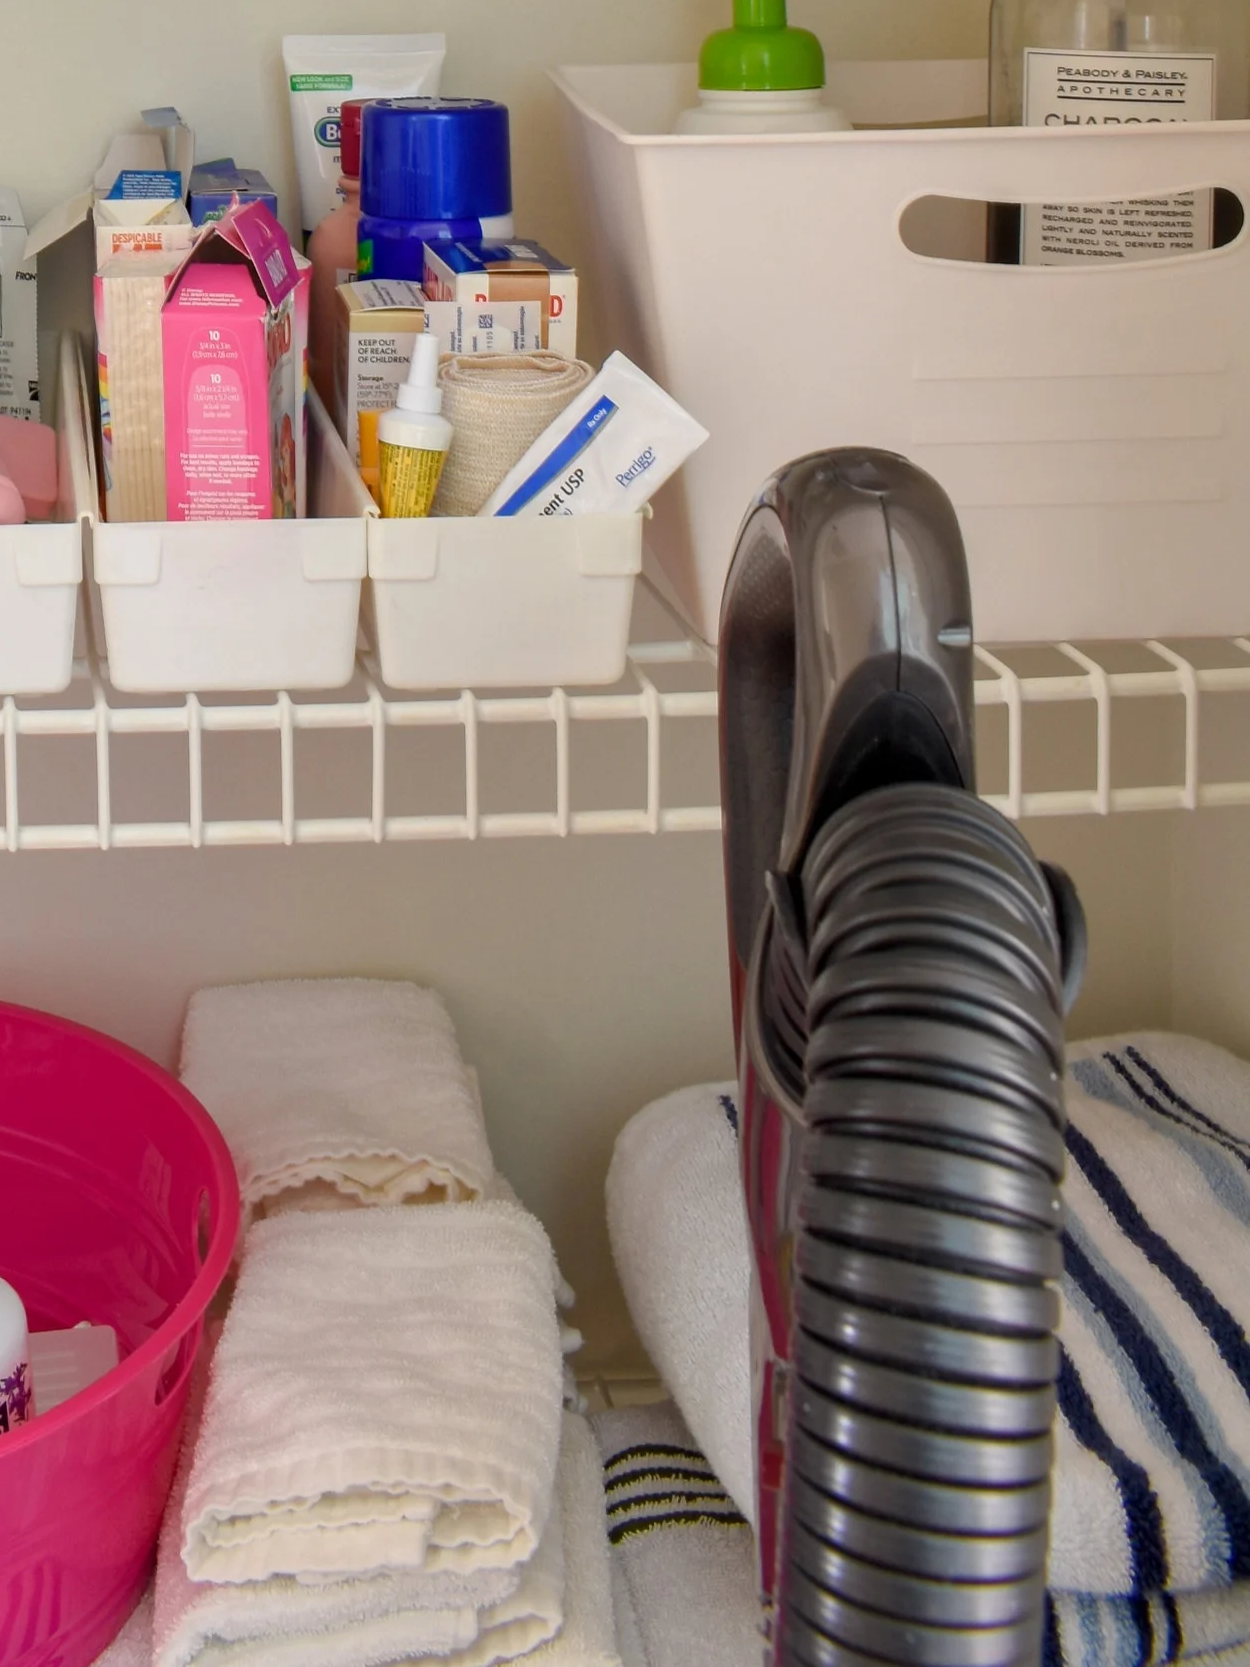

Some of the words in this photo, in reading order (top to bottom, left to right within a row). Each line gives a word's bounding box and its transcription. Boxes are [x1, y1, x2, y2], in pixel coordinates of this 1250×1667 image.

[1057, 67, 1119, 78] PEABODY
[1122, 69, 1131, 78] &
[1057, 85, 1185, 97] APOTHECARY
[327, 106, 341, 114] EX
[1144, 210, 1194, 218] REFRESHED,
[1042, 214, 1094, 224] RECHARGED
[1123, 220, 1193, 228] REINVIGORATED.
[112, 232, 162, 243] DESPICABLE
[1042, 225, 1074, 234] LIGHTLY
[1102, 230, 1152, 238] NATURALLY
[1157, 231, 1194, 239] SCENTED
[1042, 235, 1062, 243] WITH
[1066, 237, 1100, 246] NEROLI
[1125, 241, 1165, 249] DERIVED
[1041, 245, 1074, 255] ORANGE
[1075, 249, 1125, 259] BLOSSOMS.
[209, 331, 220, 340] 10
[210, 374, 221, 384] 10
[358, 374, 383, 382] Storage
[594, 407, 608, 422] Only
[615, 446, 655, 488] Perrigo
[560, 468, 585, 496] USP
